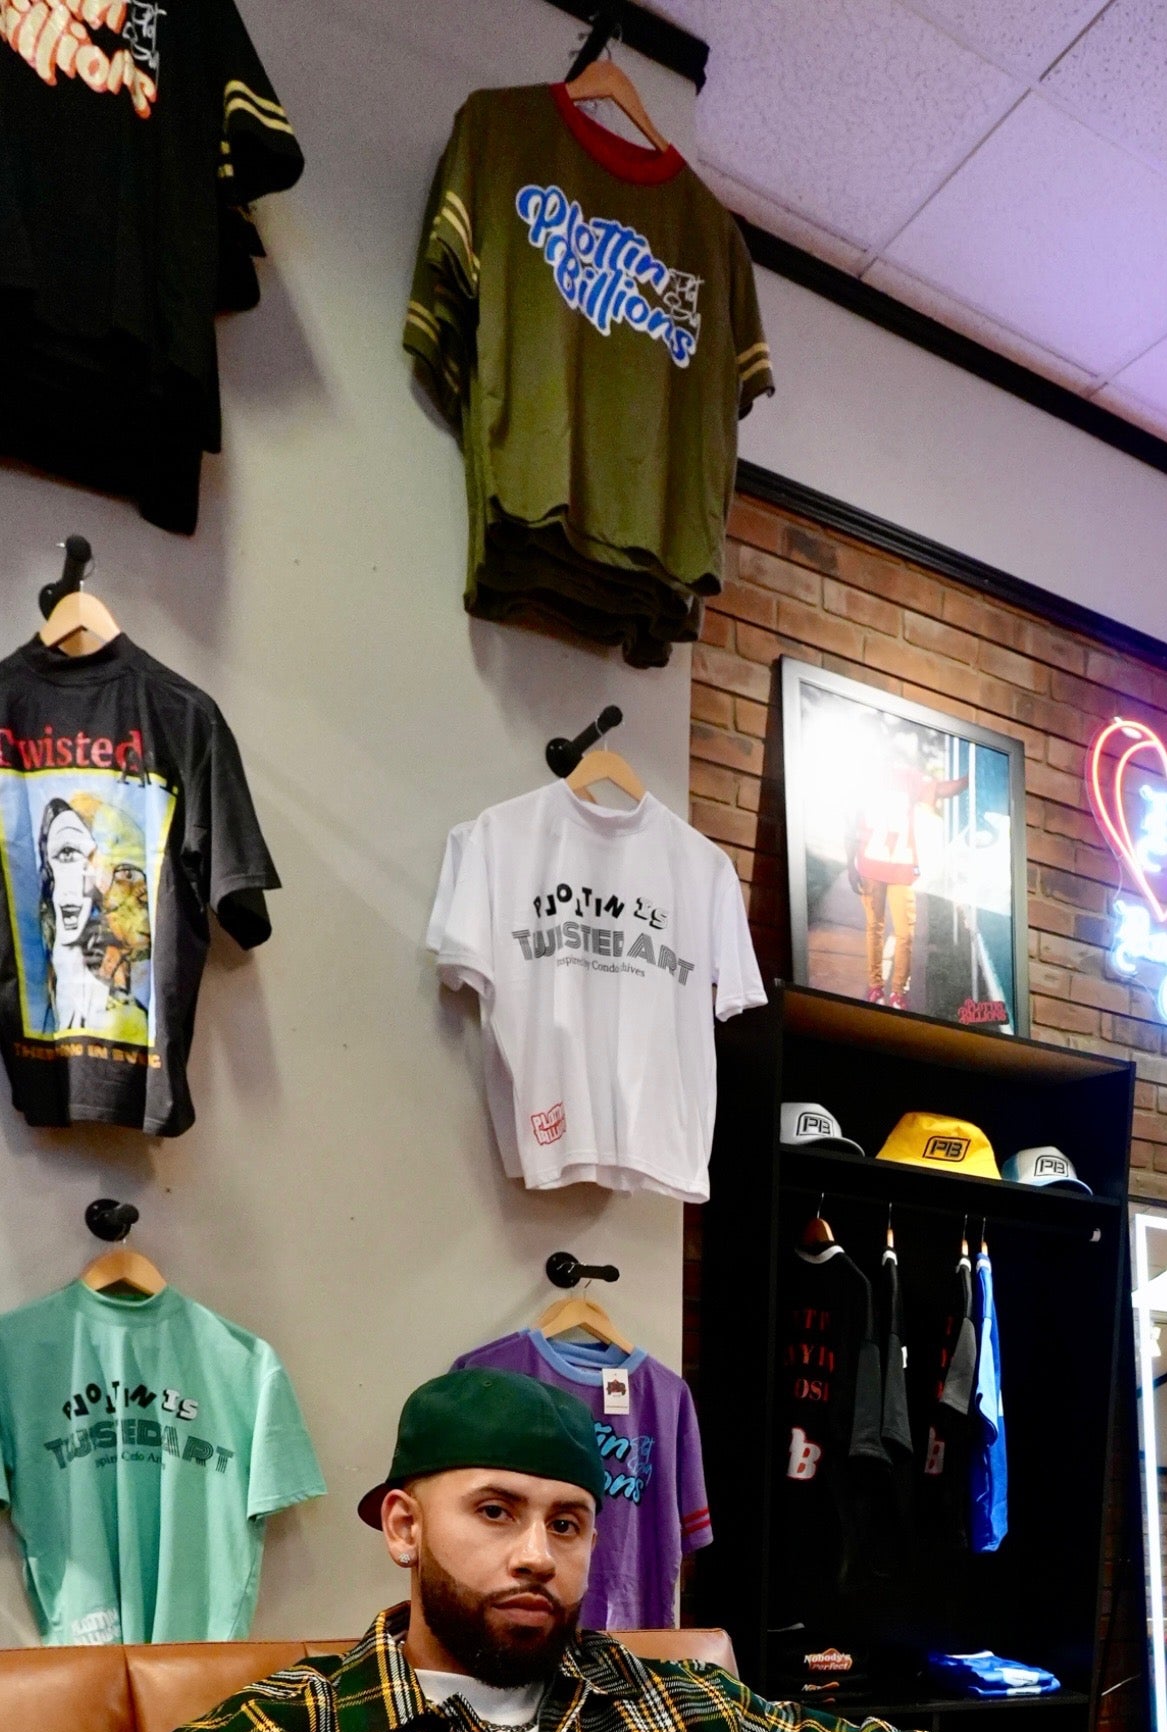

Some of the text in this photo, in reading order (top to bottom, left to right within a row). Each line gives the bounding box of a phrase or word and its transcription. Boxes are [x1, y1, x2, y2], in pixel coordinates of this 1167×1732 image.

[802, 1115, 832, 1135] PB
[929, 1139, 963, 1158] PB
[1039, 1158, 1066, 1175] PB
[162, 1387, 199, 1421] IS
